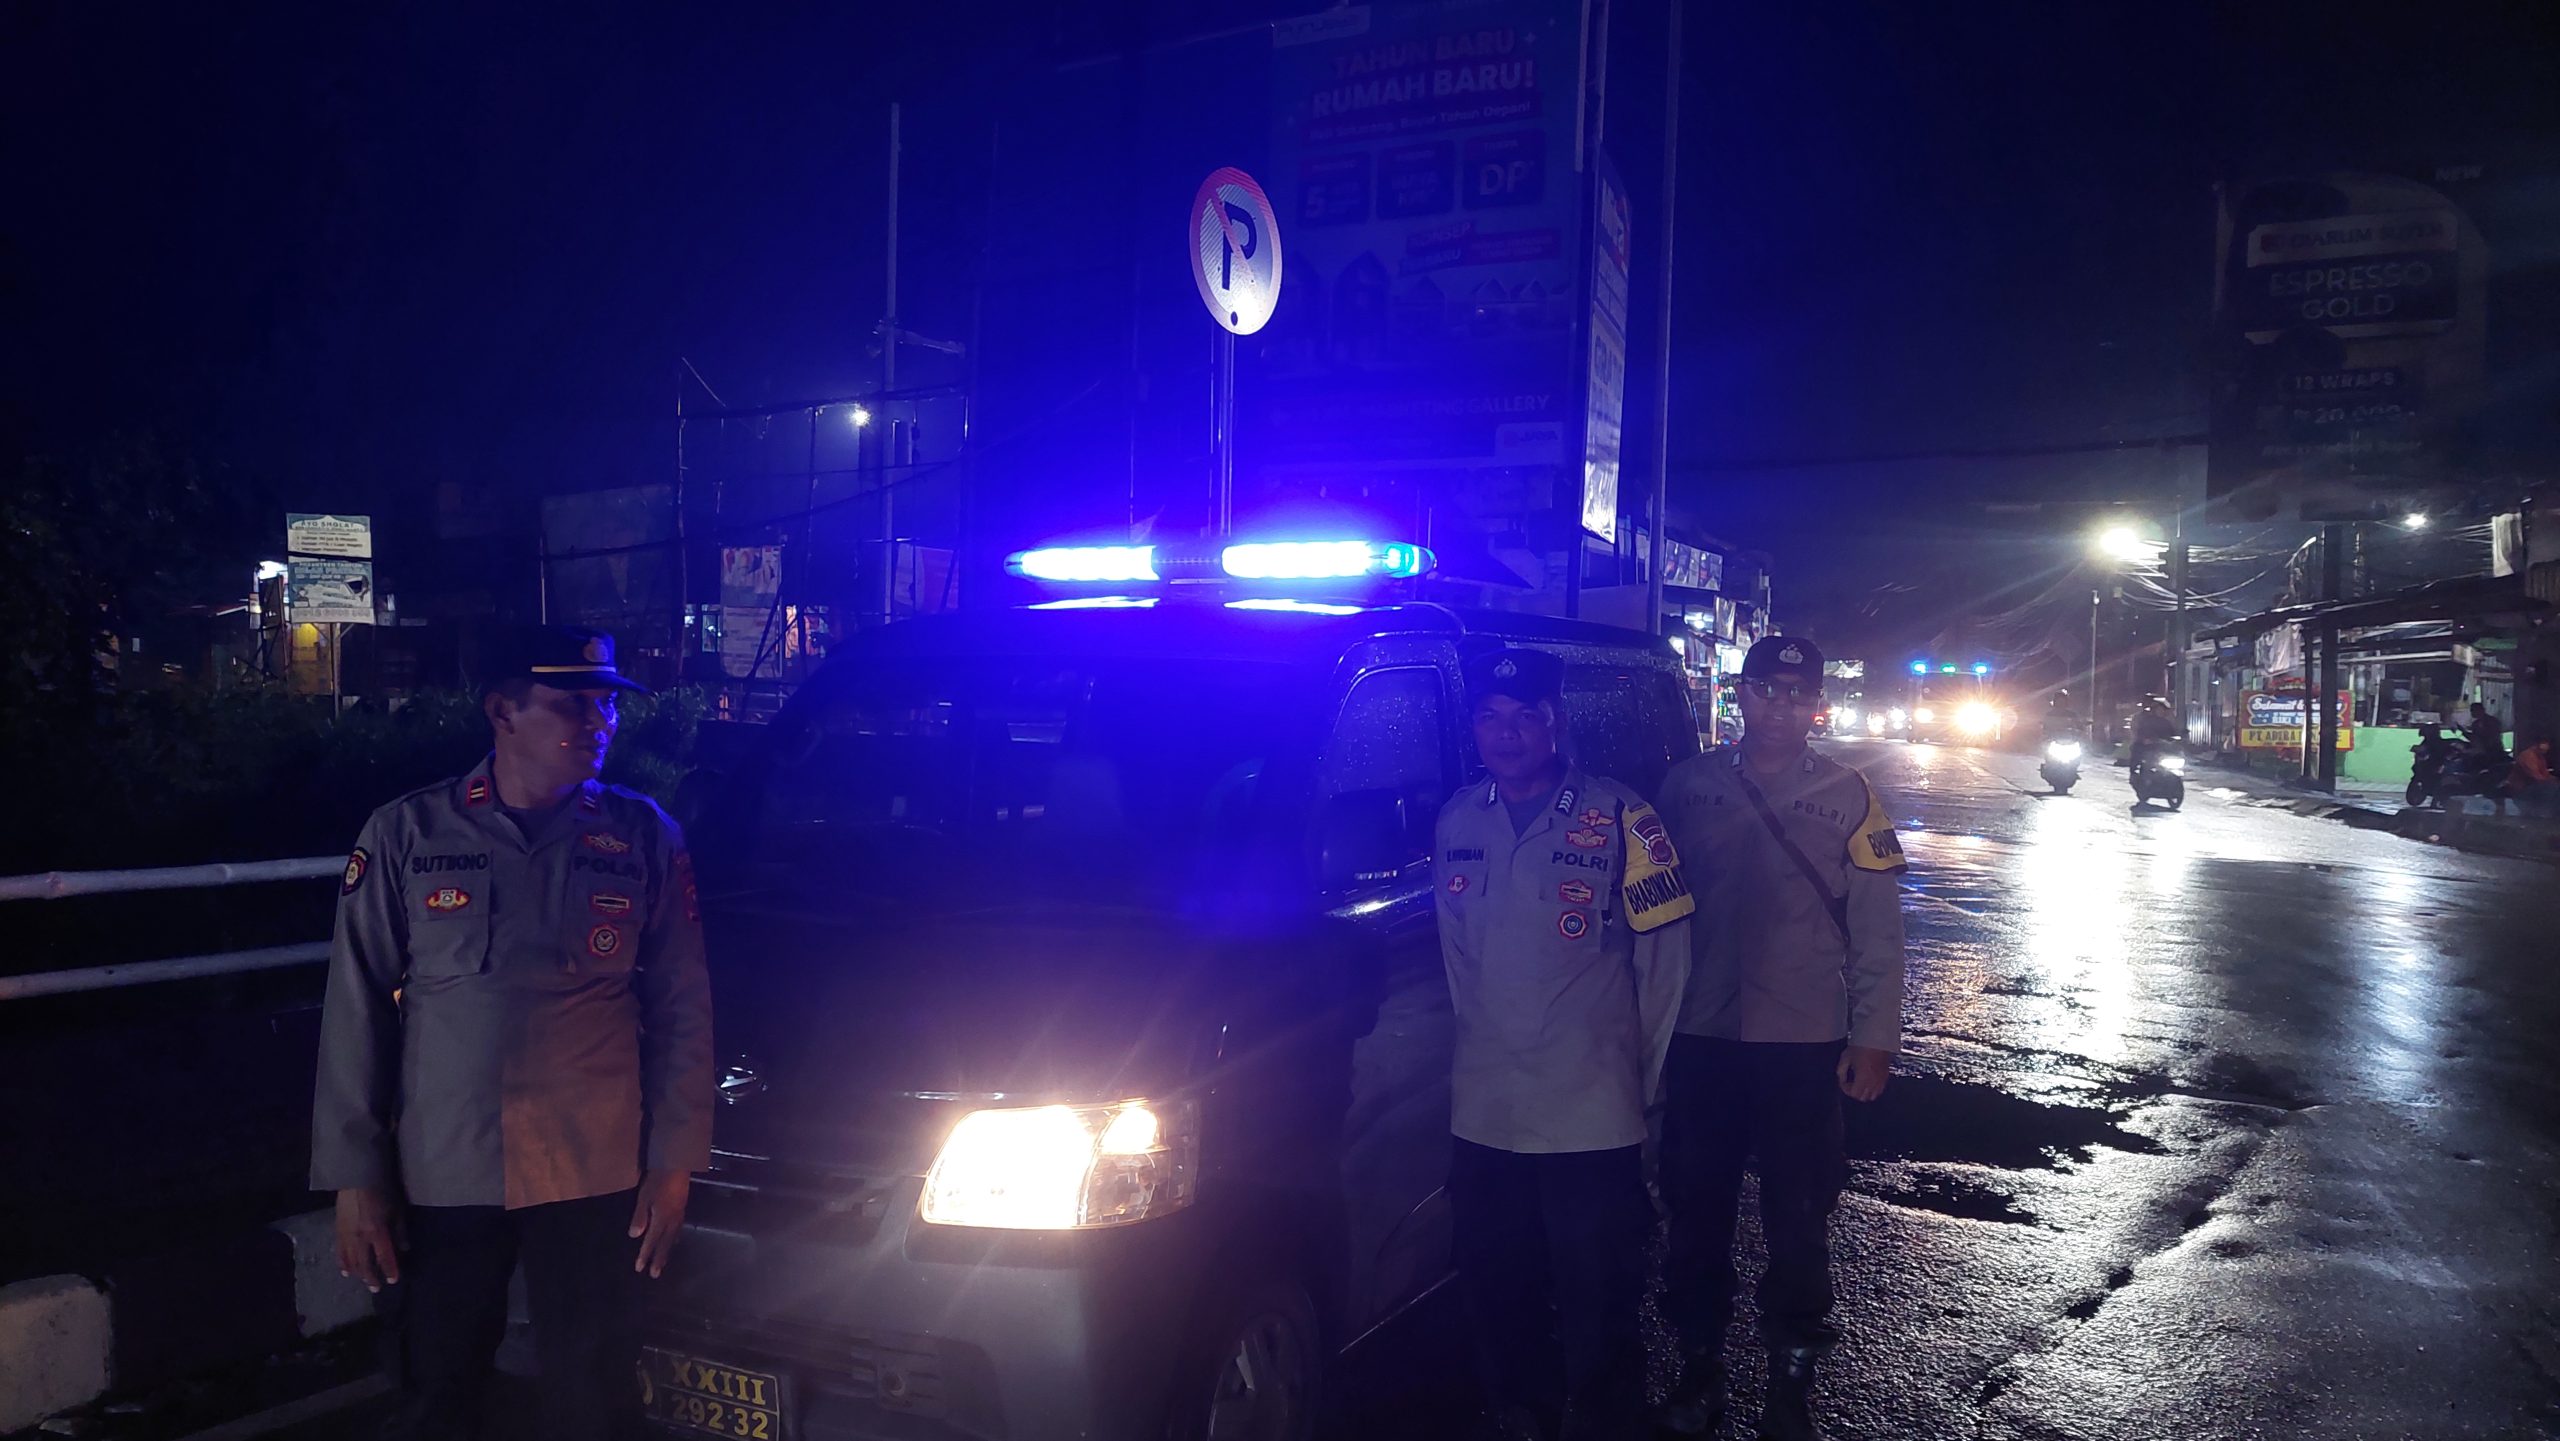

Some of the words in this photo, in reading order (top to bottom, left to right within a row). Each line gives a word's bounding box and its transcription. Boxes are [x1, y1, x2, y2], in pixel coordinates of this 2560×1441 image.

[1434, 27, 1517, 61] BARU
[1312, 71, 1427, 119] RUMAH
[1432, 59, 1536, 96] BARU!
[2269, 260, 2434, 297] ESPRESSO
[2301, 294, 2396, 320] GOLD
[1793, 800, 1847, 826] POLRI
[1552, 851, 1608, 872] POLRI
[671, 1358, 767, 1406] XXIII
